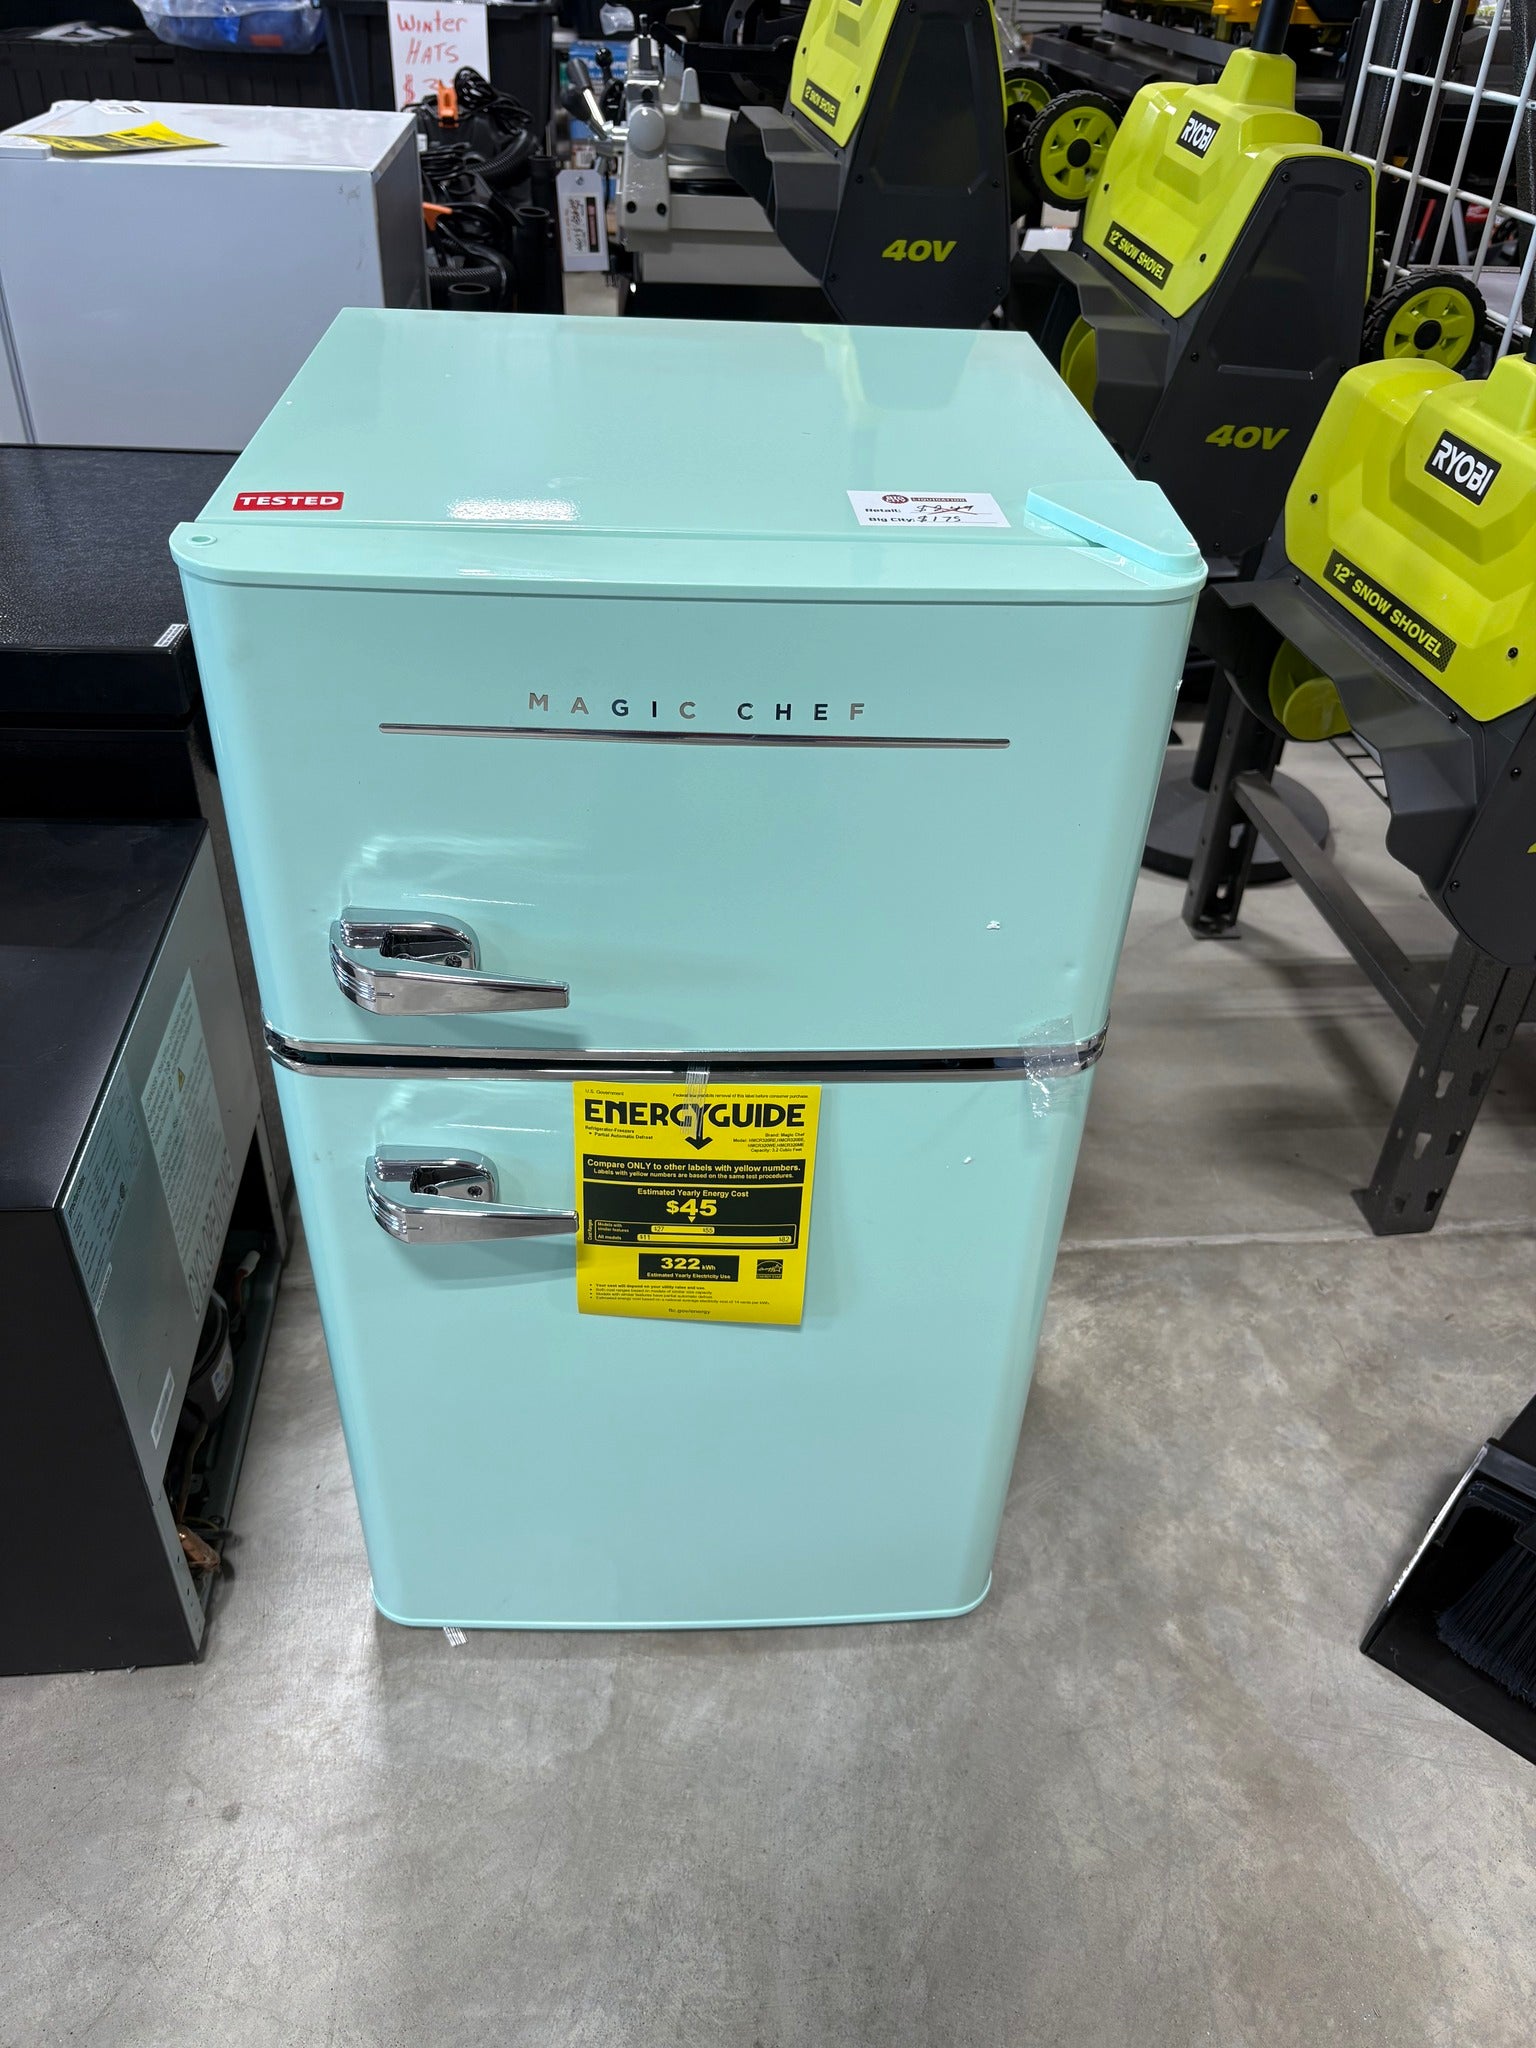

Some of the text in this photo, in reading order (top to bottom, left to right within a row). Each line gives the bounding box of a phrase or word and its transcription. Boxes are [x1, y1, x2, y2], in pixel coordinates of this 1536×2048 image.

[405, 37, 460, 65] HATS
[1180, 117, 1217, 152] RYOBI
[881, 239, 958, 263] 40V
[1117, 237, 1141, 260] SNOW
[1136, 251, 1166, 281] SHOVEL
[1204, 424, 1290, 450] 40V
[1431, 438, 1495, 497] RYOBI
[239, 496, 339, 506] TESTED
[917, 515, 961, 523] $175
[1351, 578, 1393, 615] SNOW
[1389, 608, 1442, 659] SHOVEL
[528, 692, 865, 721] MAGIC CHEF
[584, 1098, 806, 1128] ENERGYGUIDE
[587, 1158, 626, 1170] Compare
[626, 1161, 652, 1170] ONLY
[663, 1163, 686, 1171] other
[687, 1163, 713, 1172] labels
[733, 1164, 761, 1173] yellow
[762, 1164, 801, 1172] numbers.
[593, 1167, 614, 1175] Labels
[628, 1170, 649, 1178] yellow
[758, 1172, 794, 1180] procedures.
[637, 1187, 749, 1199] Estimated Yearly Energy Cost
[665, 1198, 718, 1217] $45
[660, 1257, 701, 1270] 322
